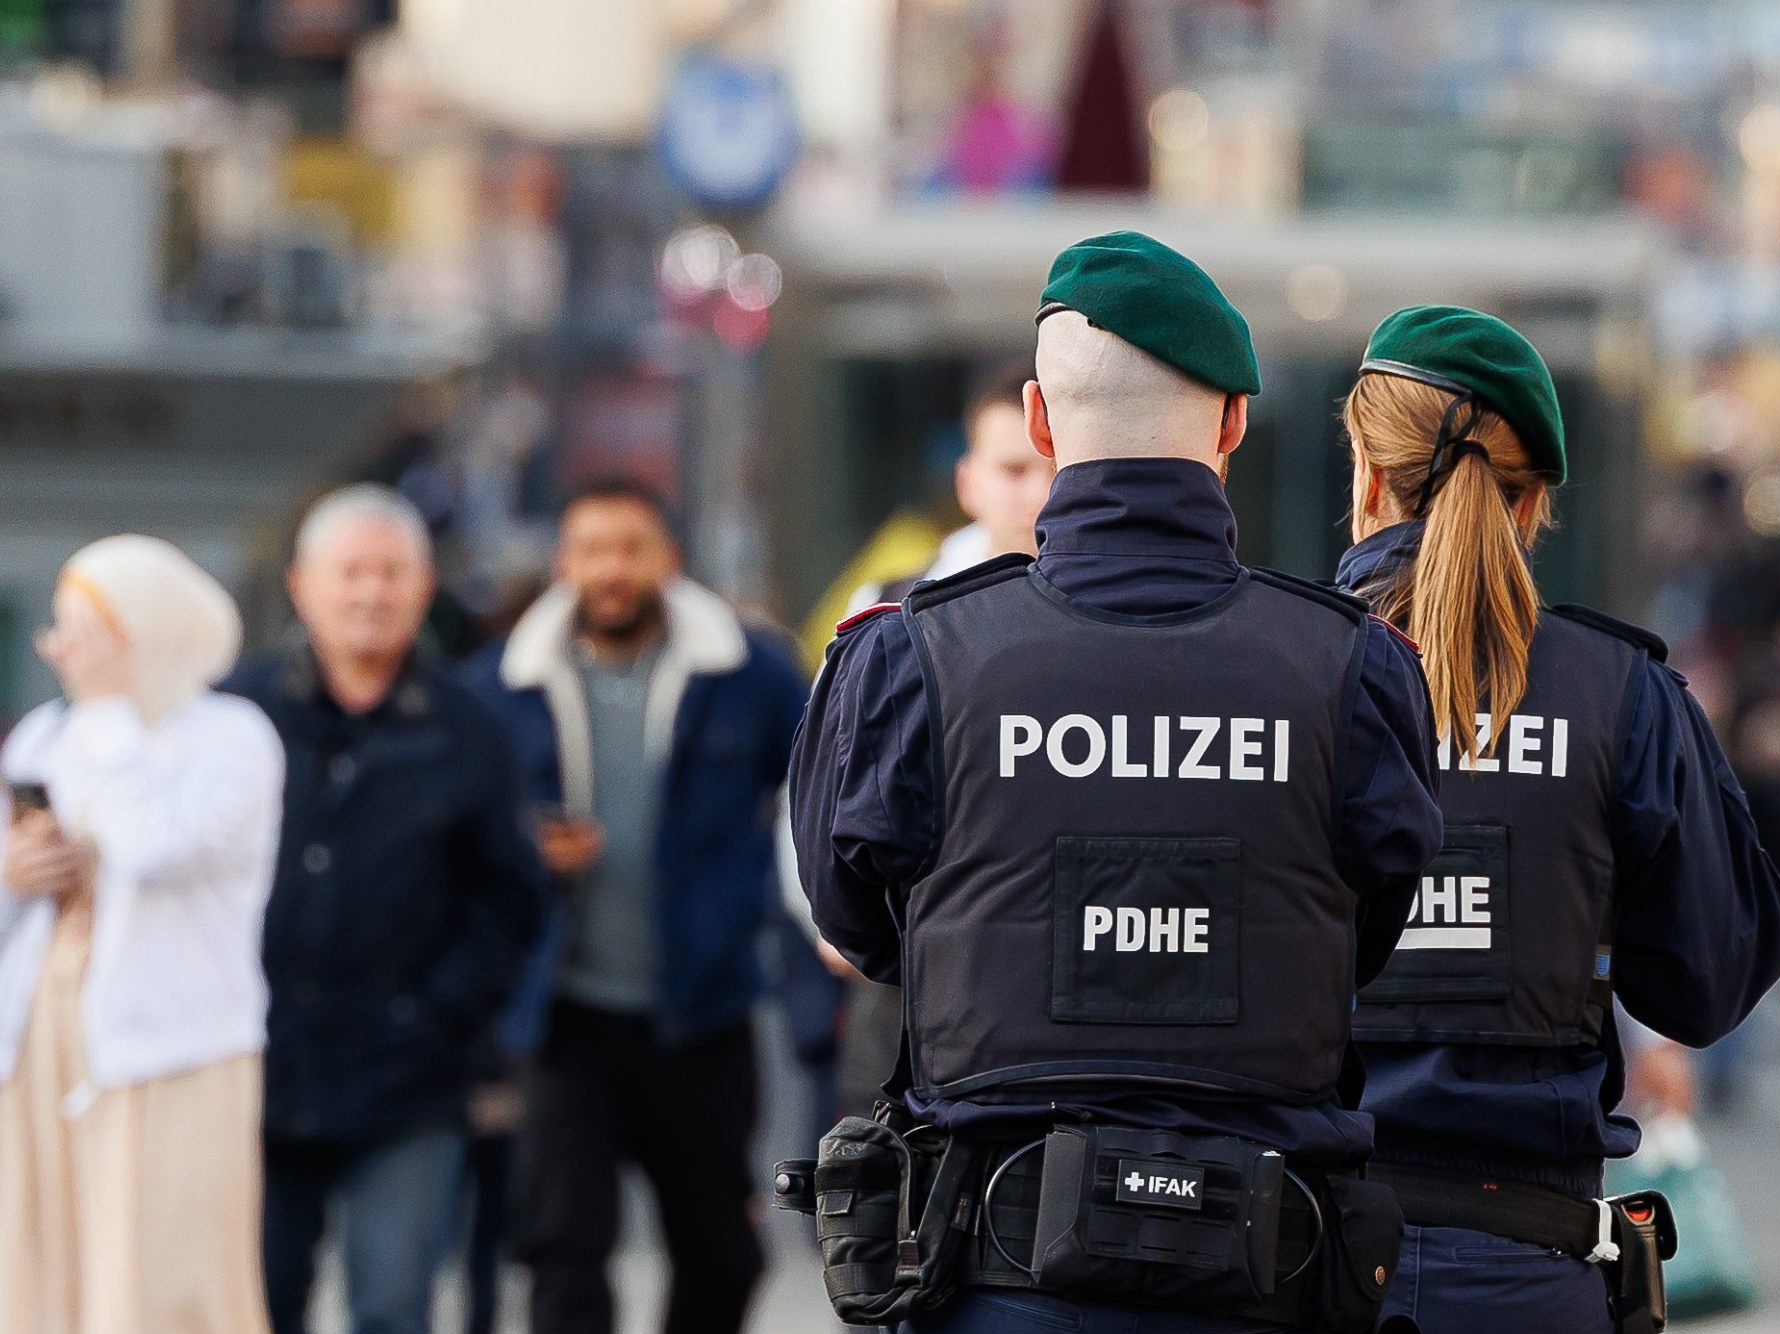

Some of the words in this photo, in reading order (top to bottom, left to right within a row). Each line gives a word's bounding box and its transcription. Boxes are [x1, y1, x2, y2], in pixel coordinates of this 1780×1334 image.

[998, 712, 1291, 784] POLIZEI
[1405, 875, 1493, 925] HE
[1081, 904, 1211, 954] PDHE
[1147, 1175, 1198, 1199] IFAK
